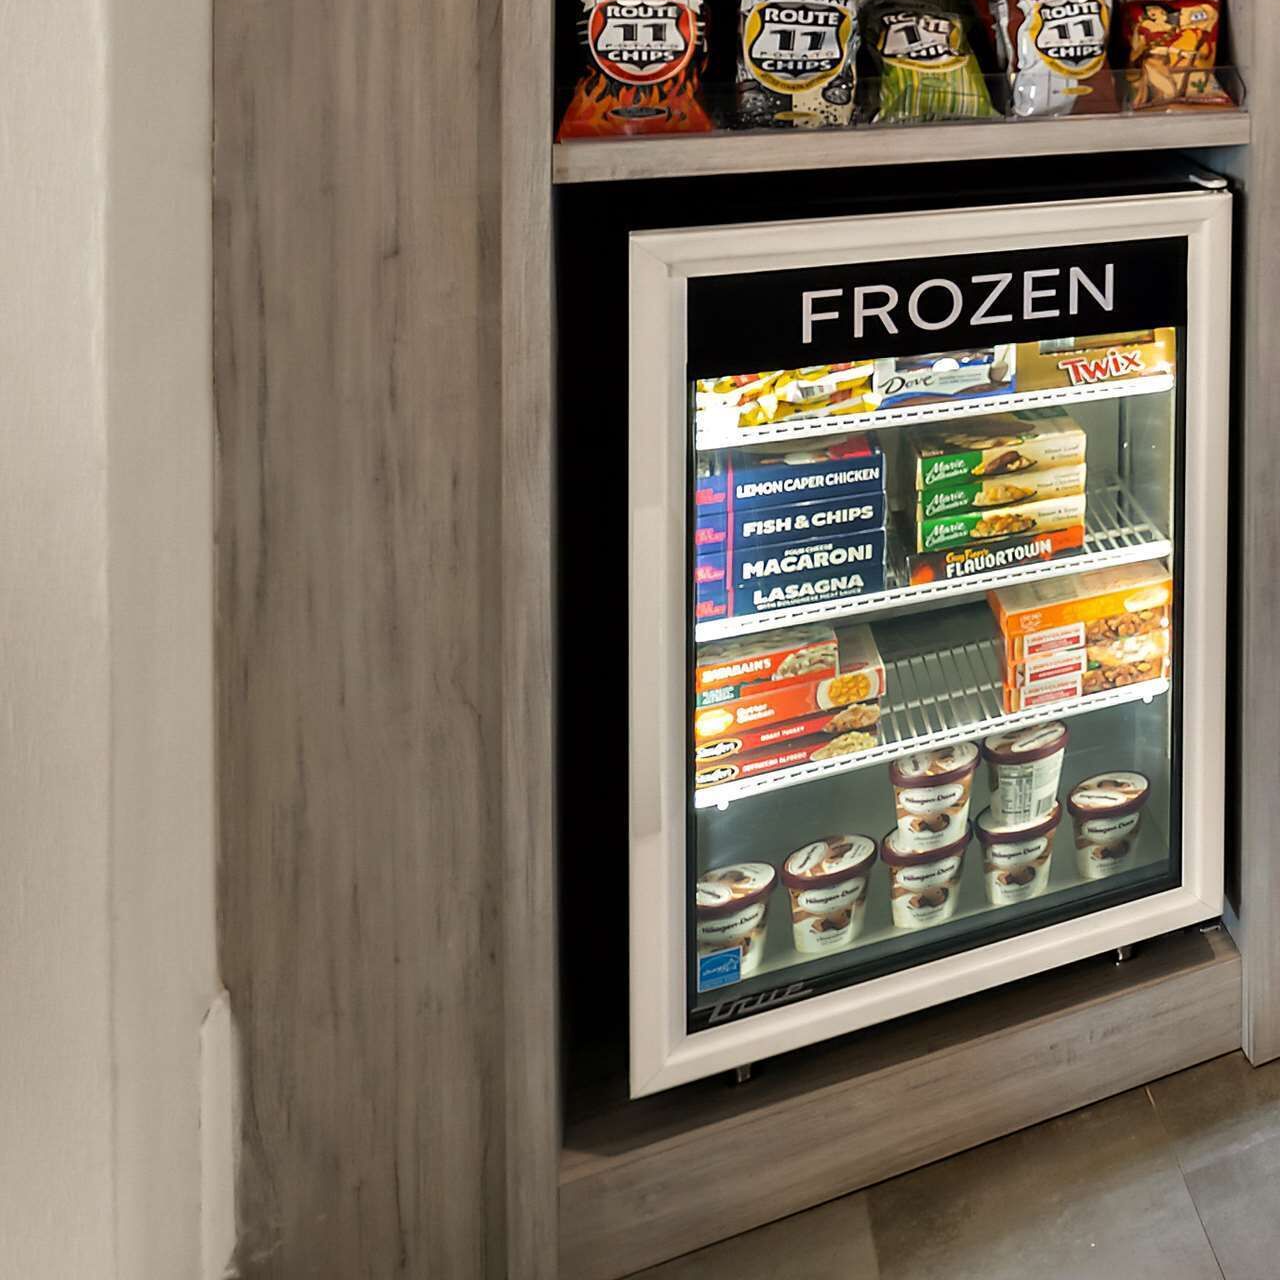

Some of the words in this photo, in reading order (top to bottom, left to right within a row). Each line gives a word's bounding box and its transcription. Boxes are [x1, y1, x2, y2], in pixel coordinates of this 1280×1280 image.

[606, 5, 677, 18] ROUTE
[764, 7, 840, 25] ROUTE
[1041, 1, 1099, 19] ROUTE
[613, 23, 667, 41] 11
[1048, 18, 1094, 39] 11
[770, 29, 826, 51] 11
[607, 51, 675, 61] CHIPS
[1047, 46, 1102, 58] CHIPS
[761, 60, 832, 70] CHIPS
[801, 262, 1116, 345] FROZEN
[1060, 350, 1142, 385] Twix
[880, 374, 936, 395] Dove
[736, 480, 783, 499] LEMON
[783, 474, 824, 492] CAPER
[825, 467, 880, 486] CHICKEN
[742, 517, 792, 537] FISH
[793, 514, 810, 531] &
[811, 505, 874, 527] CHIPS
[742, 544, 873, 580] MACARONI
[753, 574, 865, 605] LASAGNA
